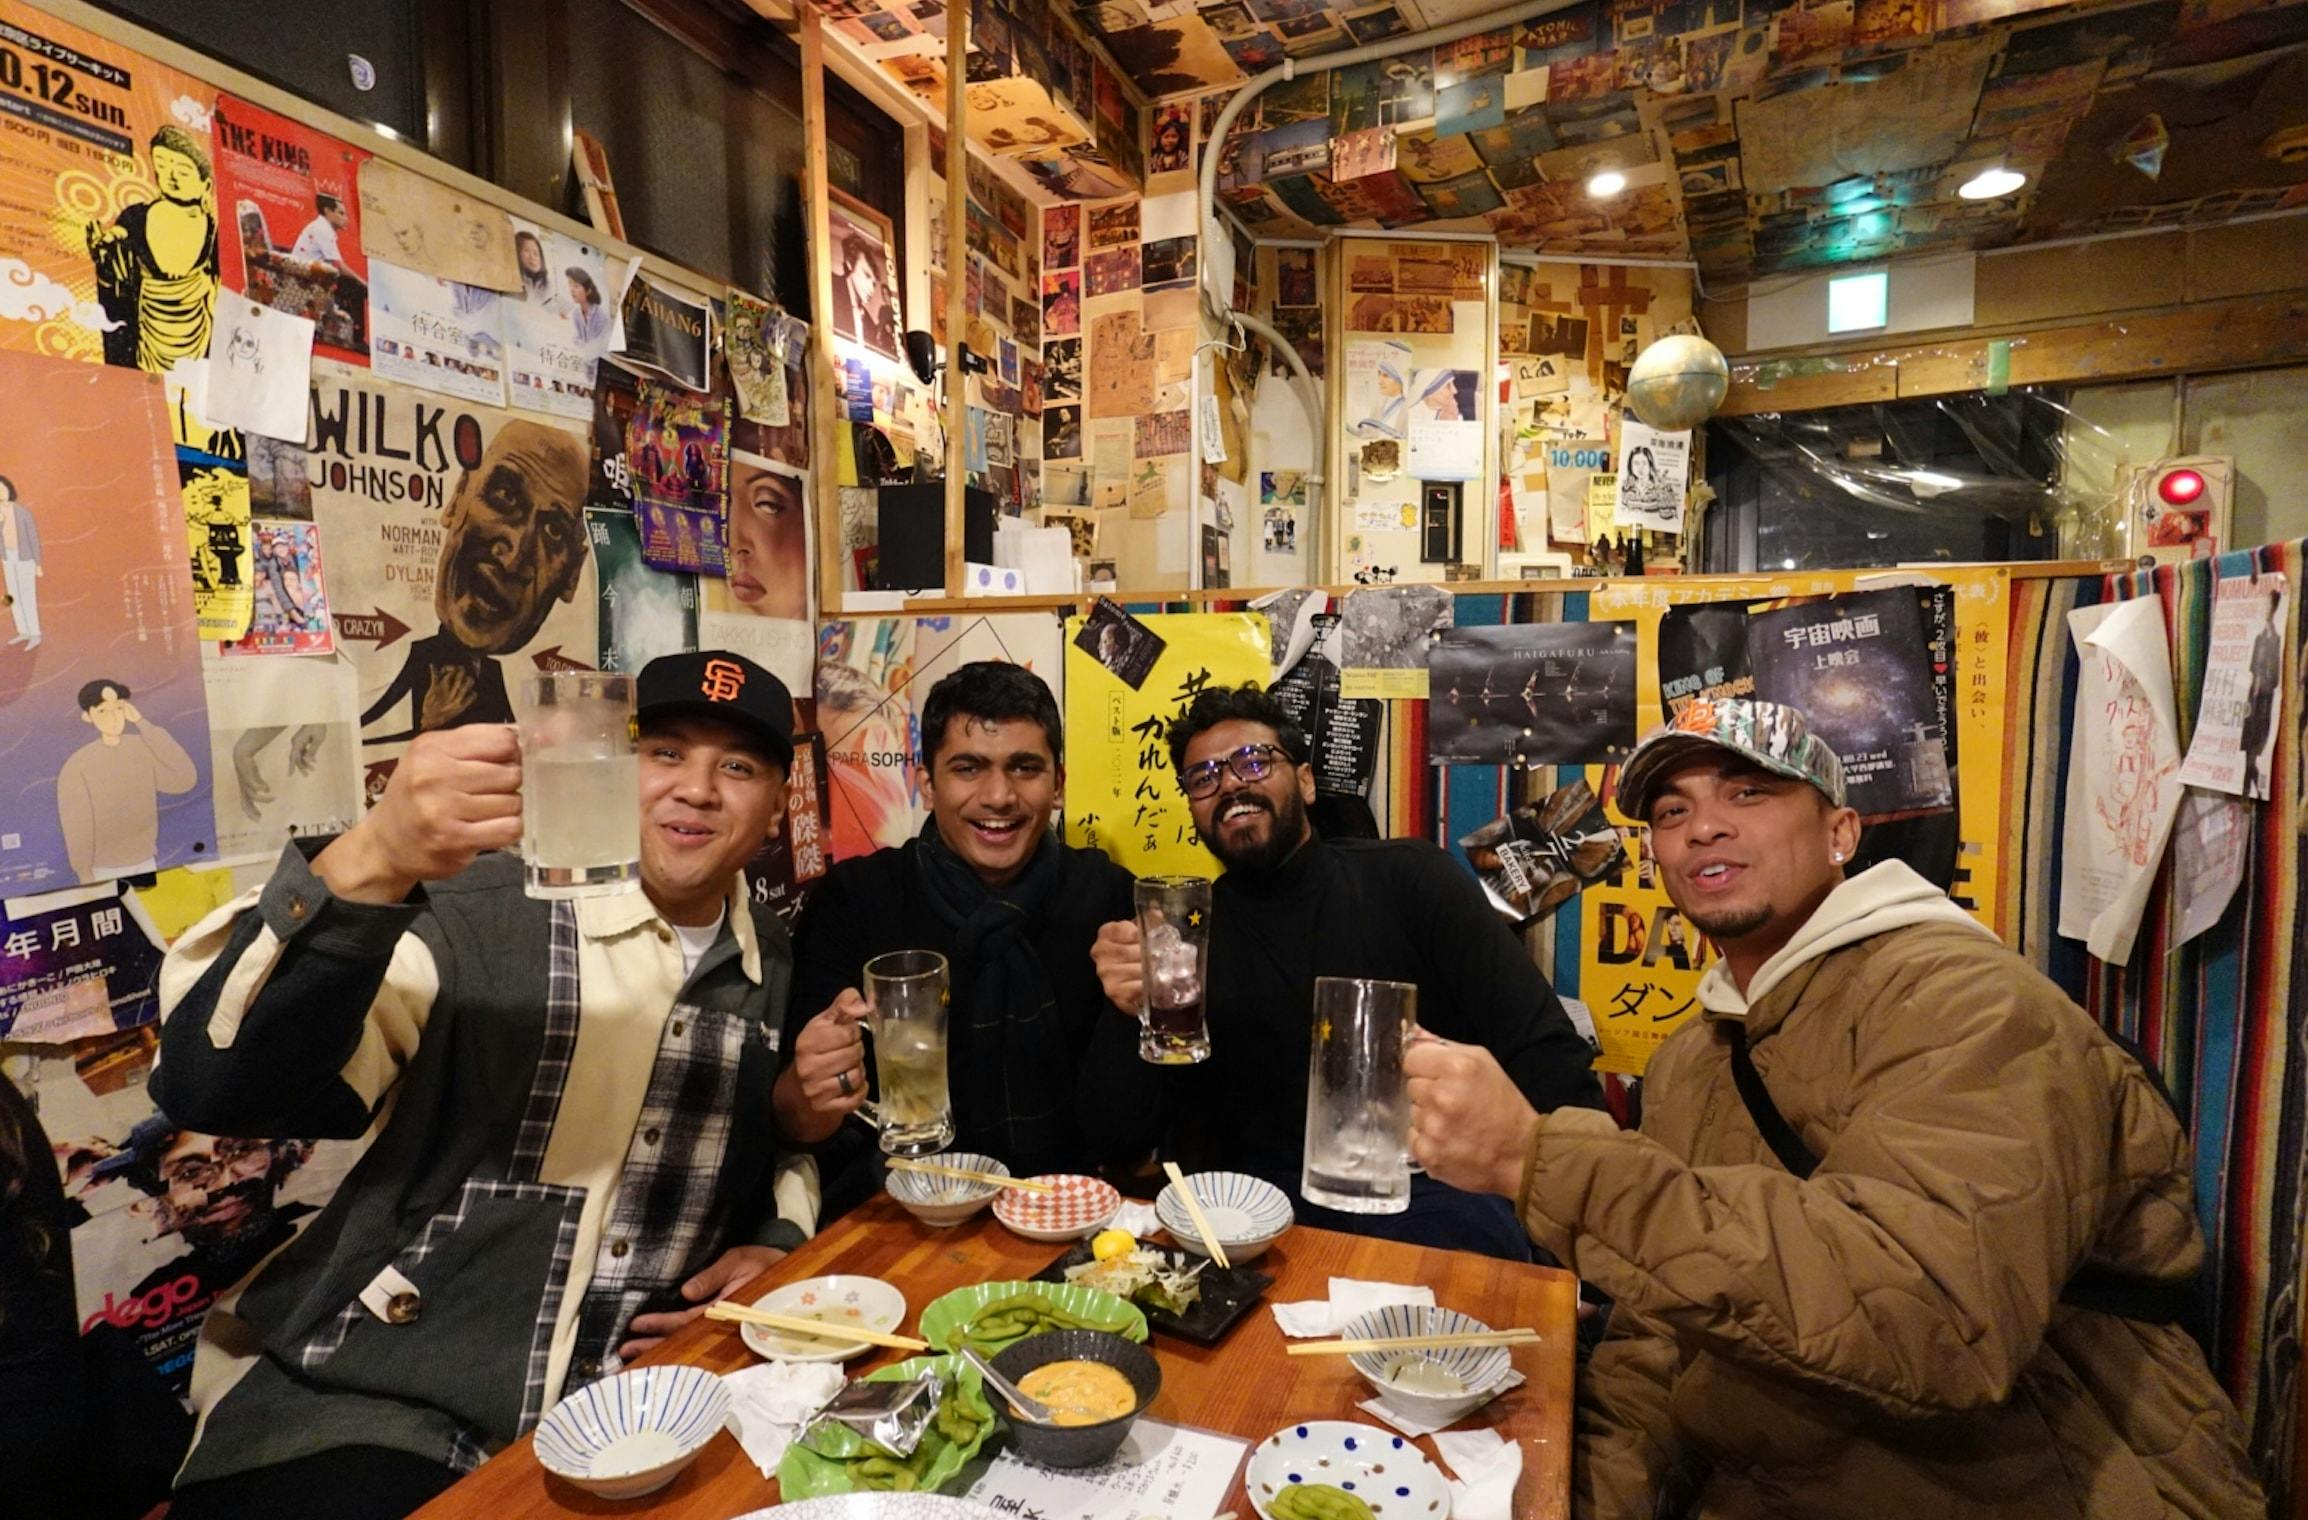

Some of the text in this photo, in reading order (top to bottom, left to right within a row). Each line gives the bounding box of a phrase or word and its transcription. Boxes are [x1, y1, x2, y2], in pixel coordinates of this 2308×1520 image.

[883, 241, 898, 294] BOB
[306, 388, 483, 474] WILKO
[309, 460, 443, 509] JOHNSON
[381, 524, 441, 546] NORMAN
[385, 564, 434, 585] DYLAN
[1783, 613, 1882, 650] 宇宙映画
[701, 658, 745, 702] SF
[1813, 649, 1860, 671] 上映会
[1499, 848, 1529, 888] BAKERY
[3, 906, 124, 962] 年月間
[1608, 982, 1698, 1022] ダン
